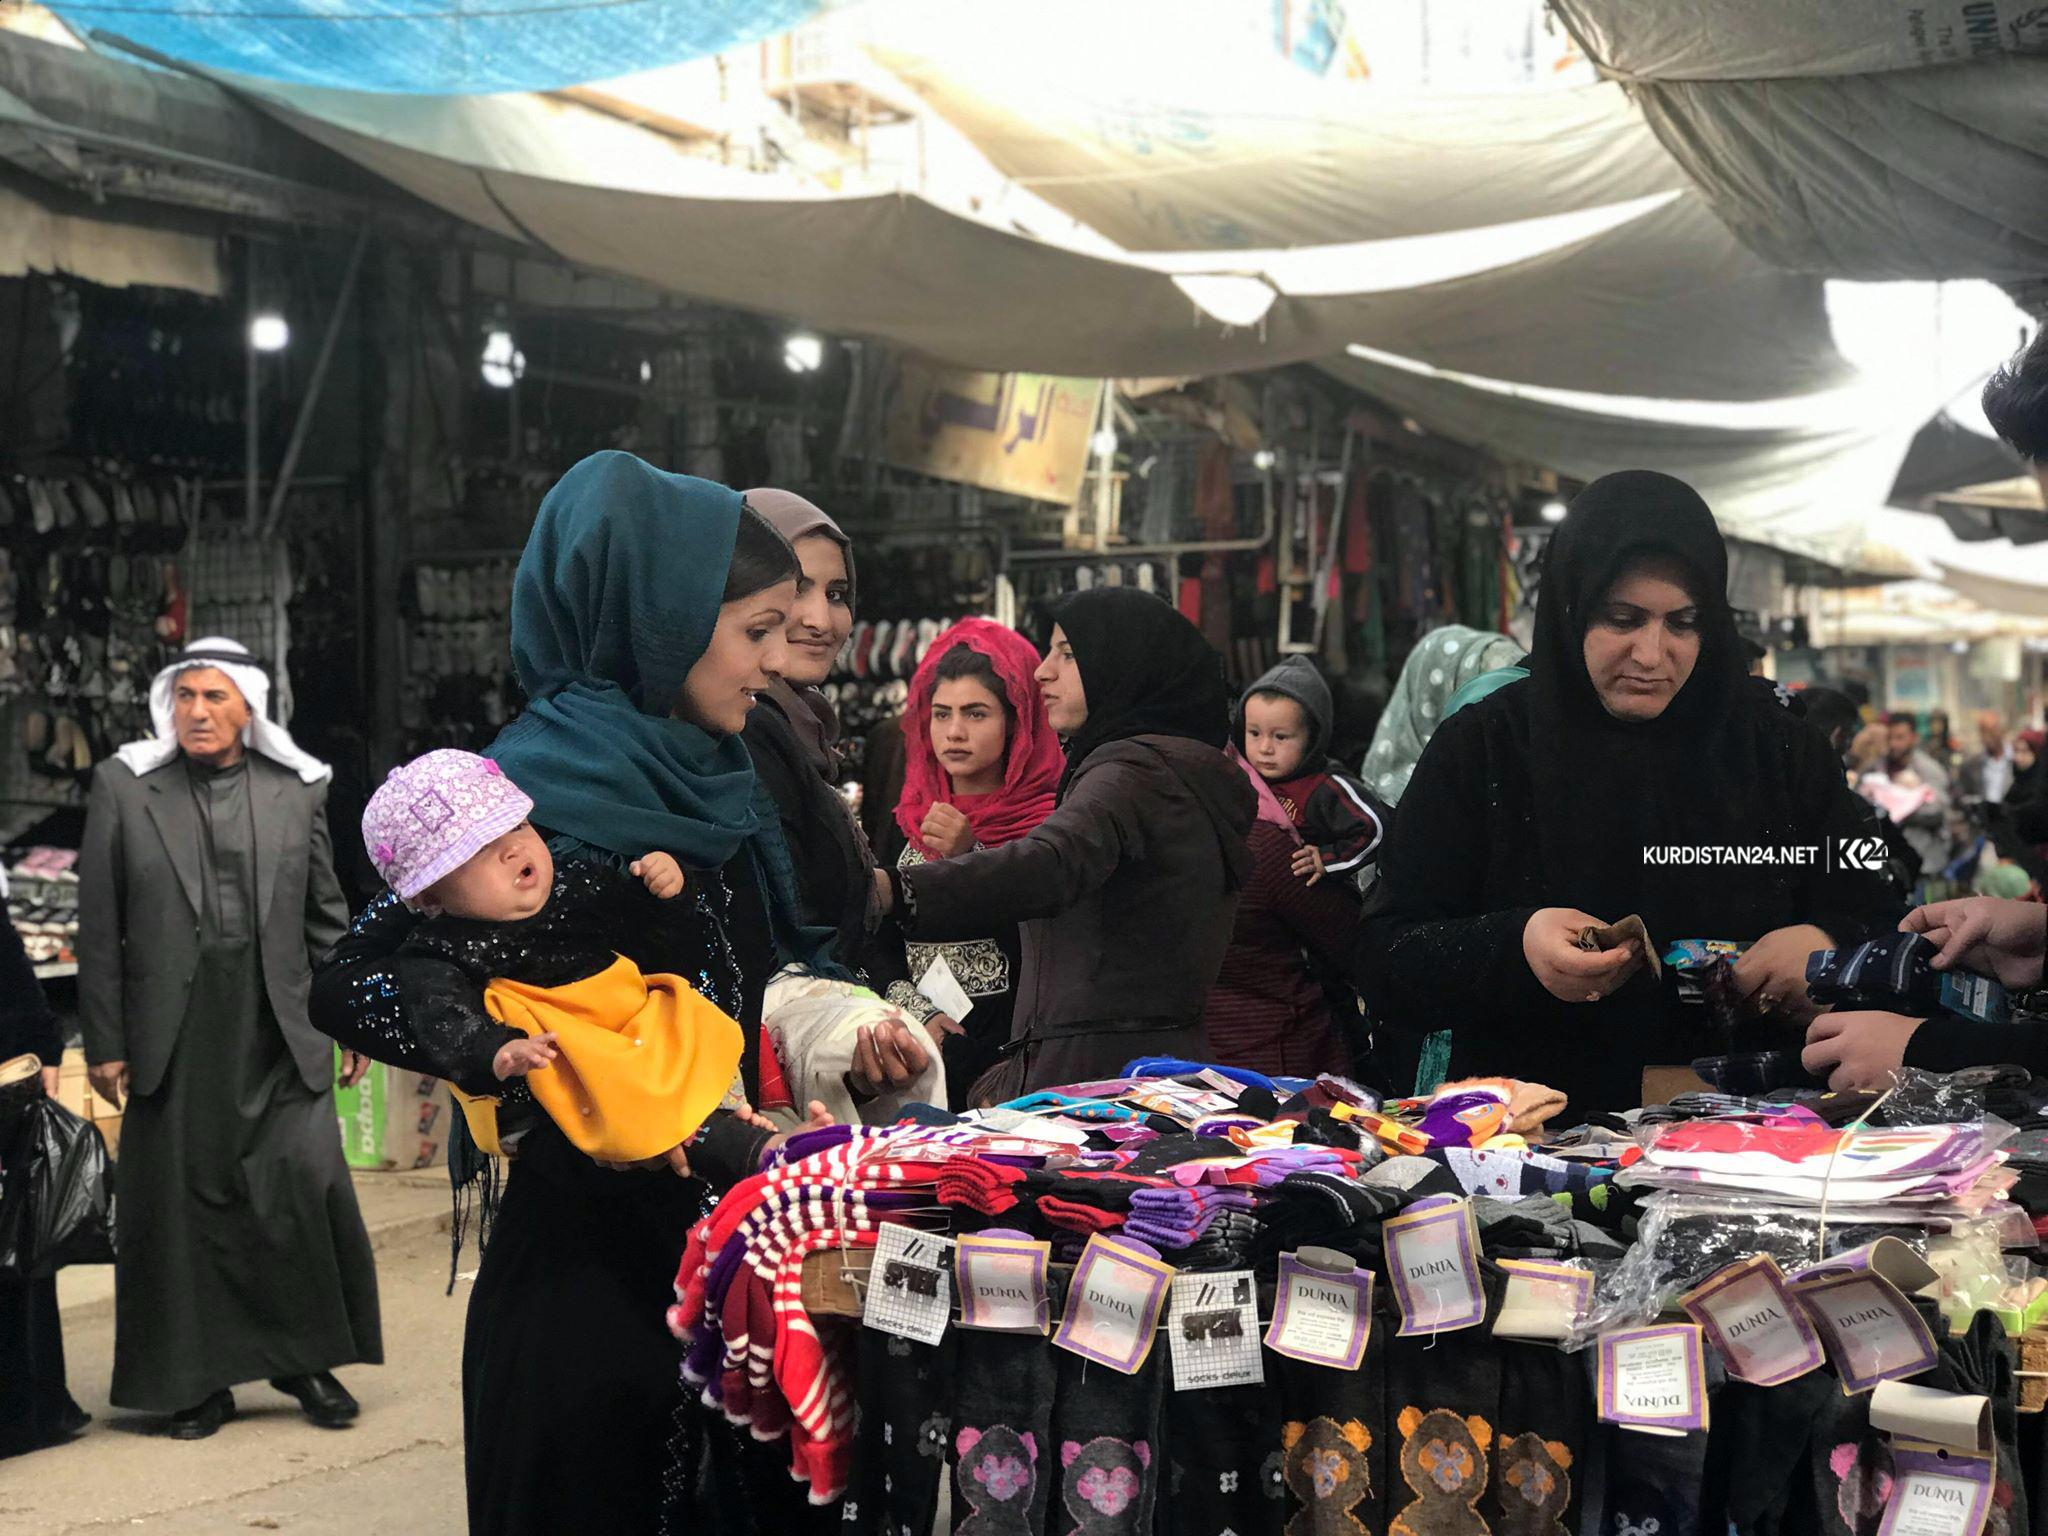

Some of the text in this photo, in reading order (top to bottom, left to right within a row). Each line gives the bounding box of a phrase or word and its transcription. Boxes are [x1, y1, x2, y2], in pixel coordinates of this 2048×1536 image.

[1409, 1258, 1458, 1279] DUNIA
[978, 1286, 1029, 1301] DUNIA
[1088, 1289, 1136, 1319] DUNIA
[1298, 1285, 1348, 1308] DUNIA
[1729, 1307, 1784, 1336] DUNIA
[1838, 1306, 1893, 1329] DUNIA
[1623, 1394, 1681, 1407] DUNIA
[1913, 1484, 1965, 1506] DUNIA
